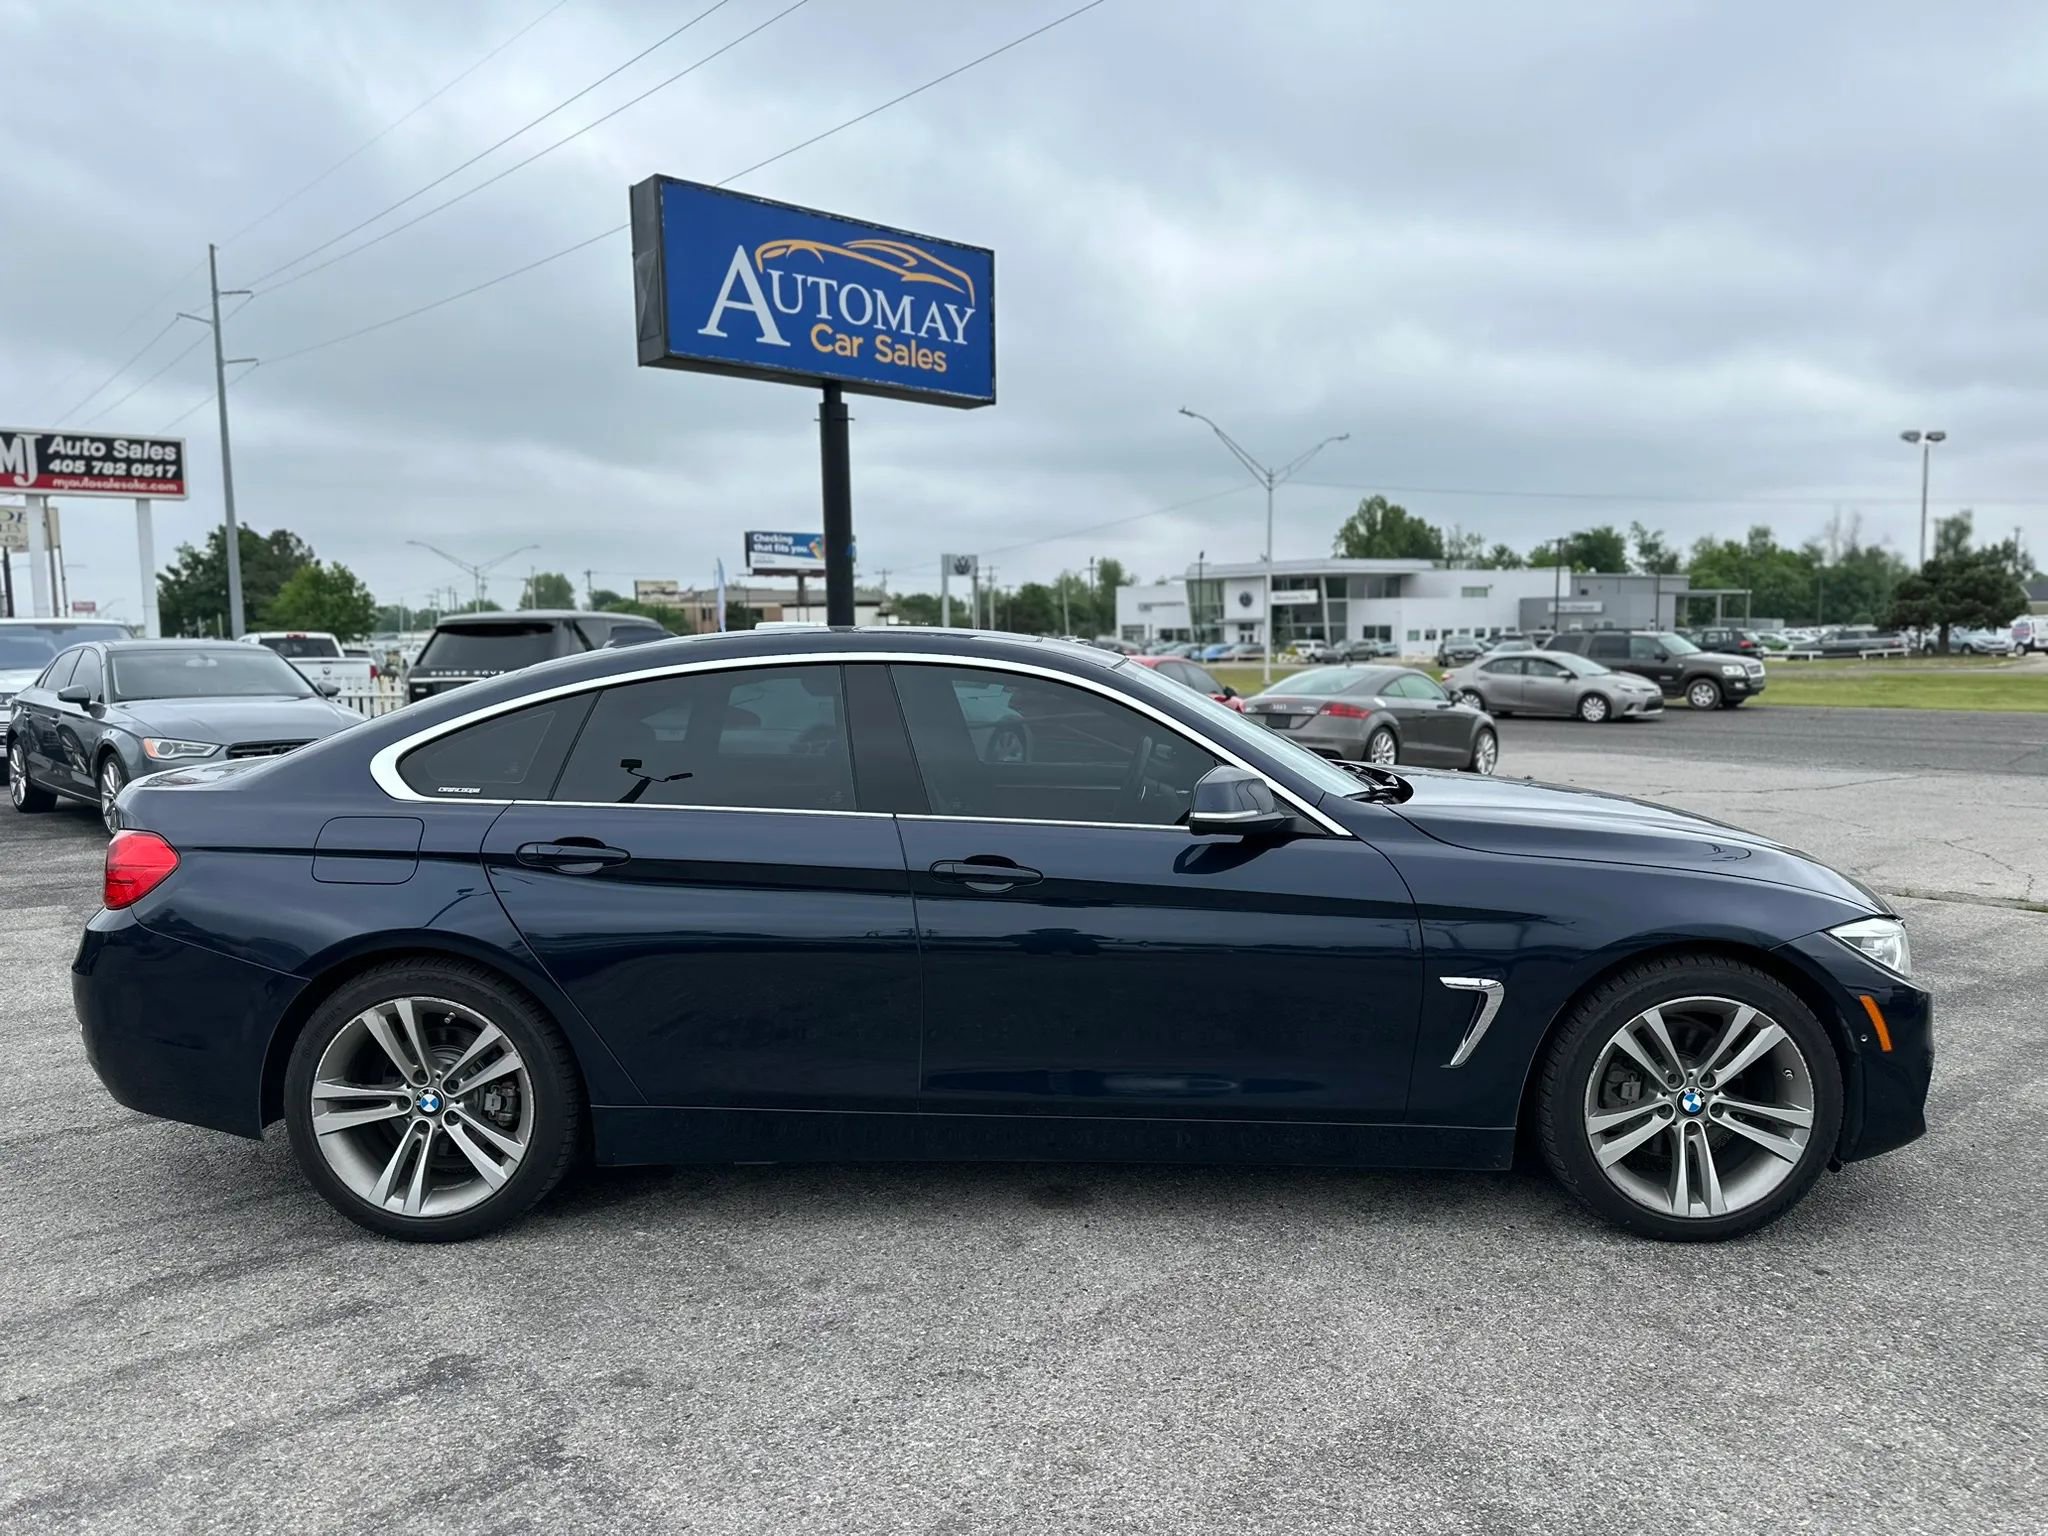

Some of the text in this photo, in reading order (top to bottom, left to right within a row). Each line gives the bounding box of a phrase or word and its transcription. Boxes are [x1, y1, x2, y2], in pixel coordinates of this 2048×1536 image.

[697, 244, 975, 347] AUTOMAY
[810, 322, 948, 373] Car Sales
[48, 436, 177, 460] Auto Sales
[48, 459, 177, 478] 405 782 0517
[753, 533, 794, 545] Checking
[753, 542, 773, 552] that
[774, 543, 789, 553] fits
